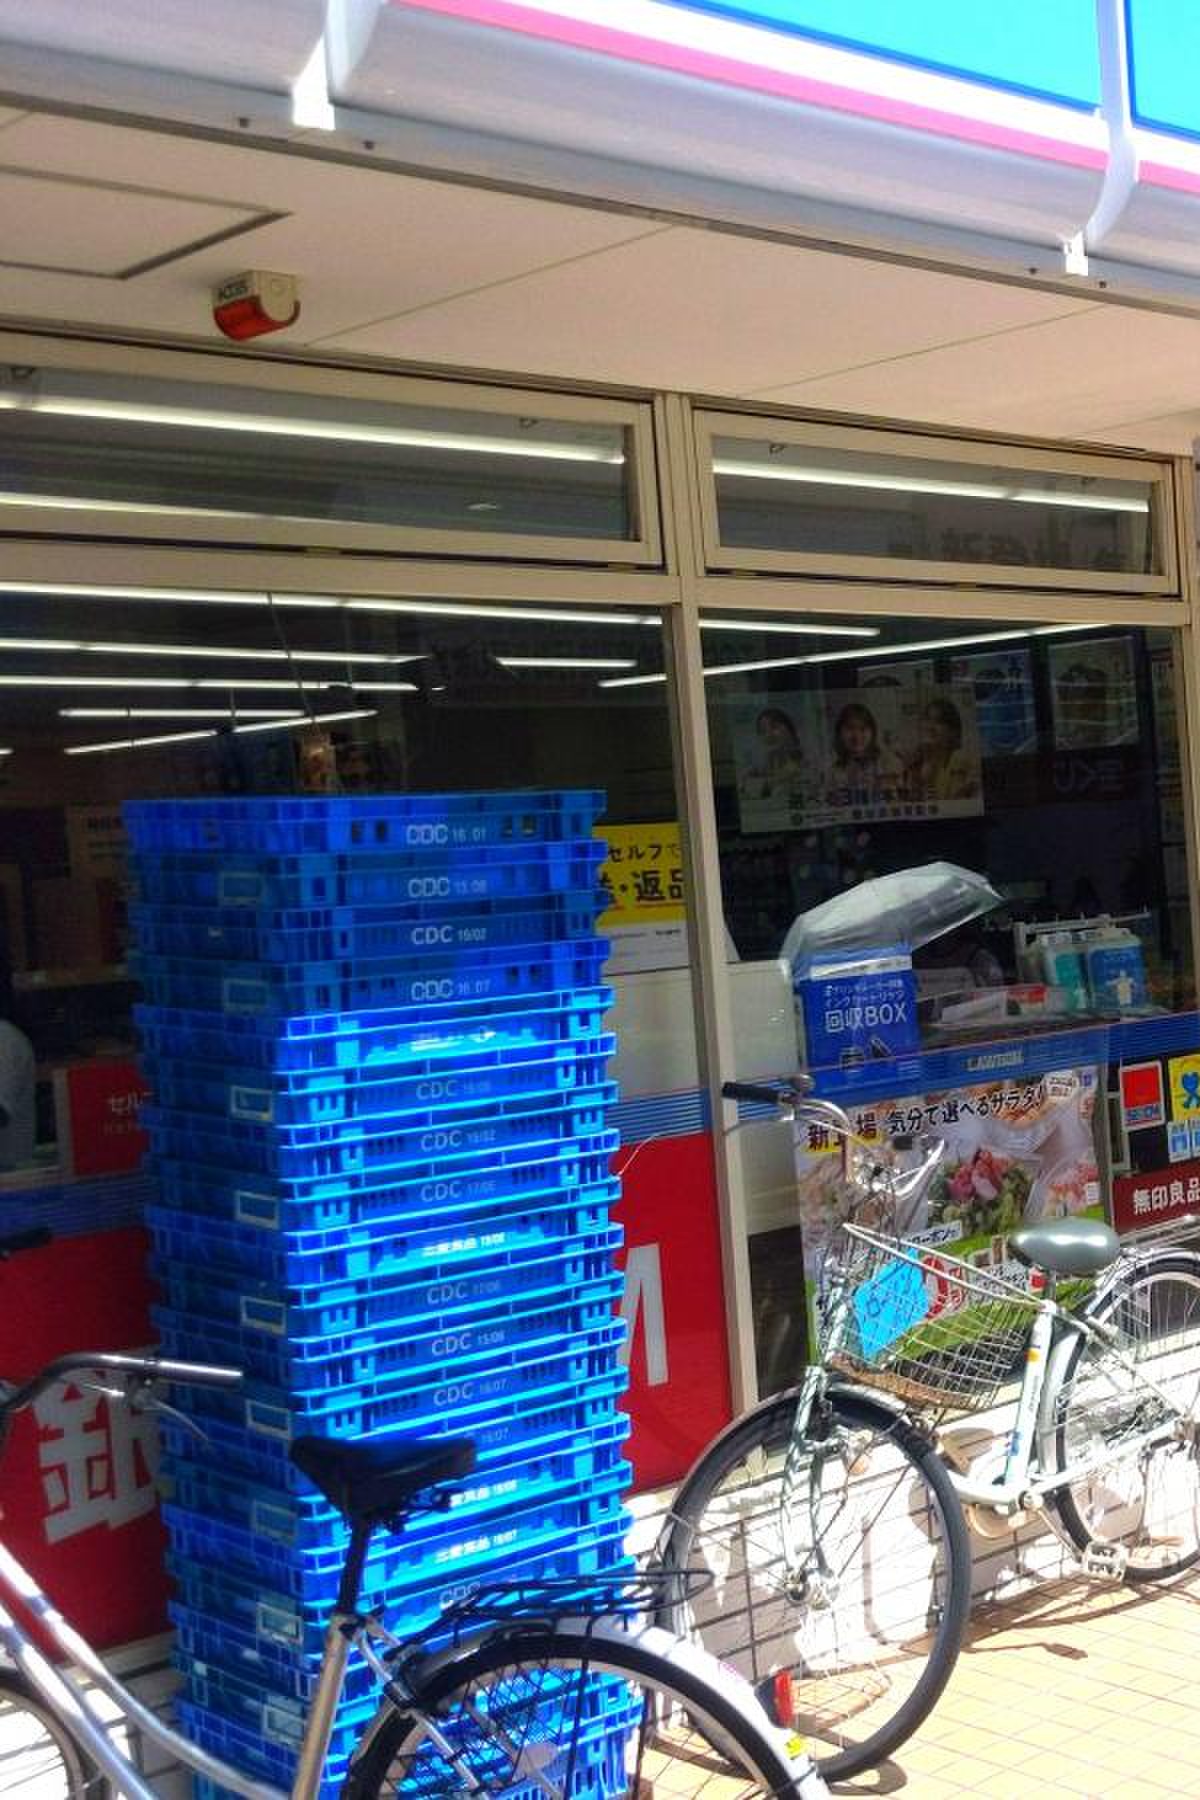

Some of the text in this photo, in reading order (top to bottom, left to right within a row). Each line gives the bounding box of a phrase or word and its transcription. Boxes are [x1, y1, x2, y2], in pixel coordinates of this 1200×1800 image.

[408, 877, 449, 898] CDC
[411, 925, 453, 945] CDC
[411, 979, 453, 1001] CDC
[825, 1002, 908, 1033] 回収BOX
[416, 1079, 458, 1100] CDC
[421, 1129, 462, 1152] CDC
[421, 1180, 461, 1202] CDC
[427, 1281, 468, 1305] CDC
[431, 1331, 472, 1356] CDC
[433, 1381, 474, 1407] CDC
